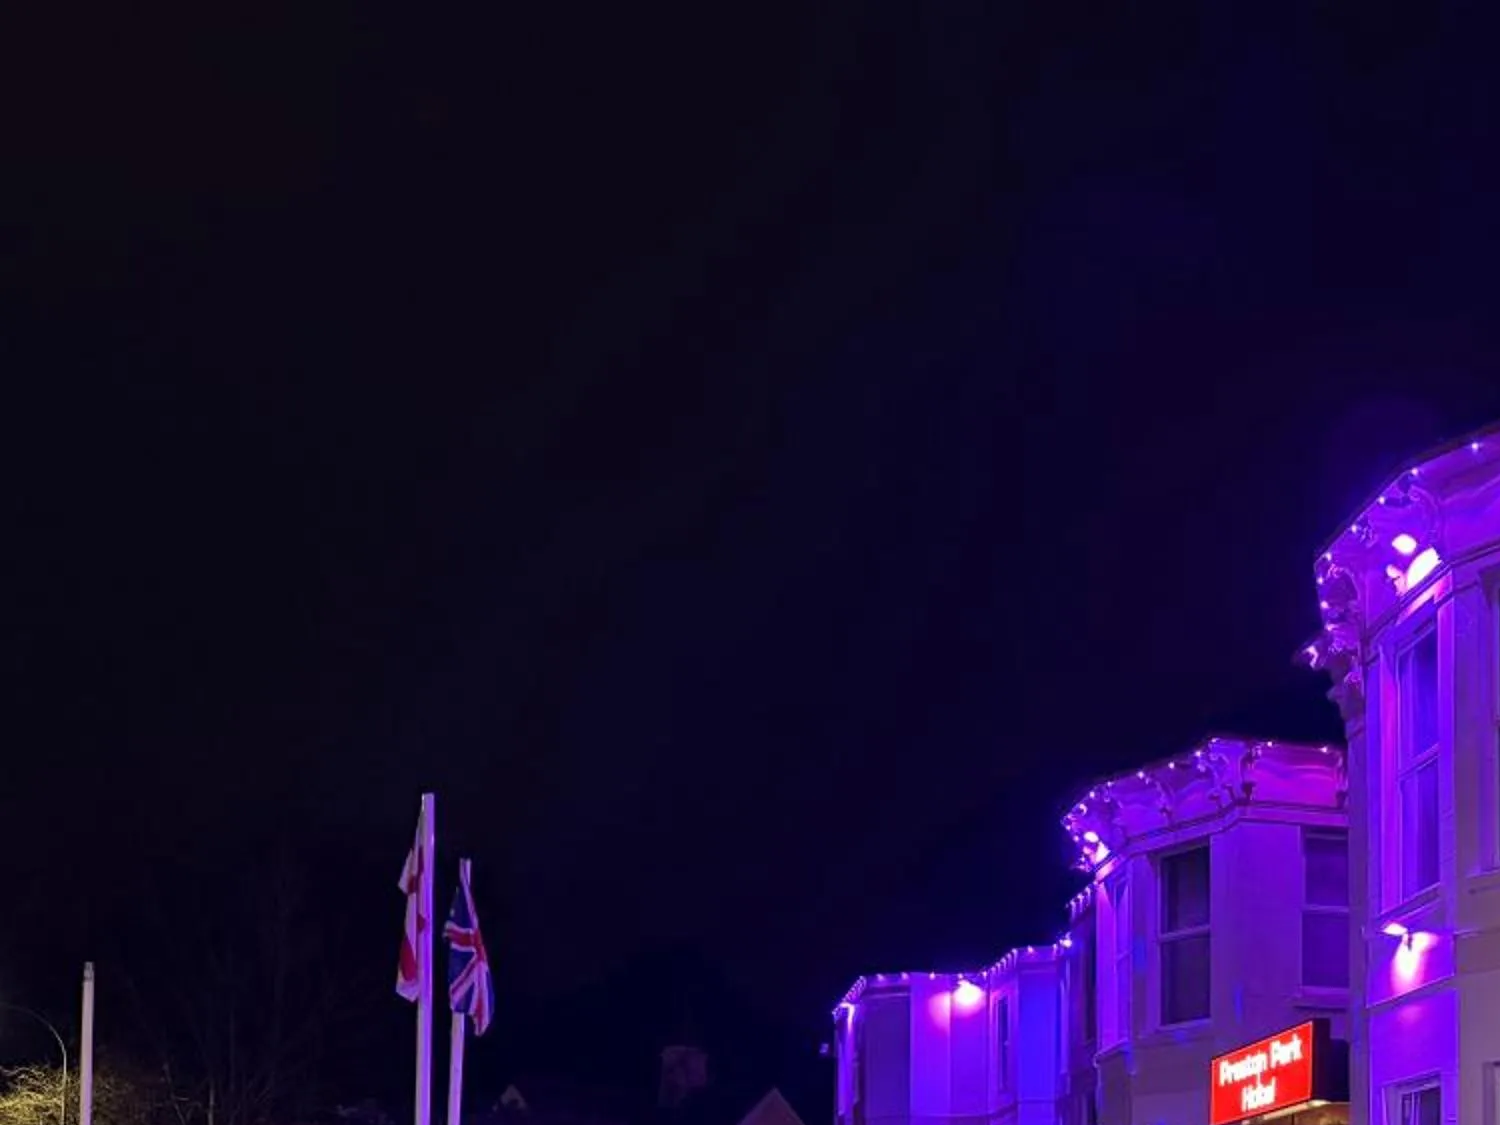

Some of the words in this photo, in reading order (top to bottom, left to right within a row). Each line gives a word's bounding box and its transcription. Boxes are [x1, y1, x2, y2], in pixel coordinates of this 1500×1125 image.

[1219, 1050, 1267, 1086] Preston
[1270, 1033, 1303, 1069] Park
[1241, 1074, 1276, 1112] Hotel
